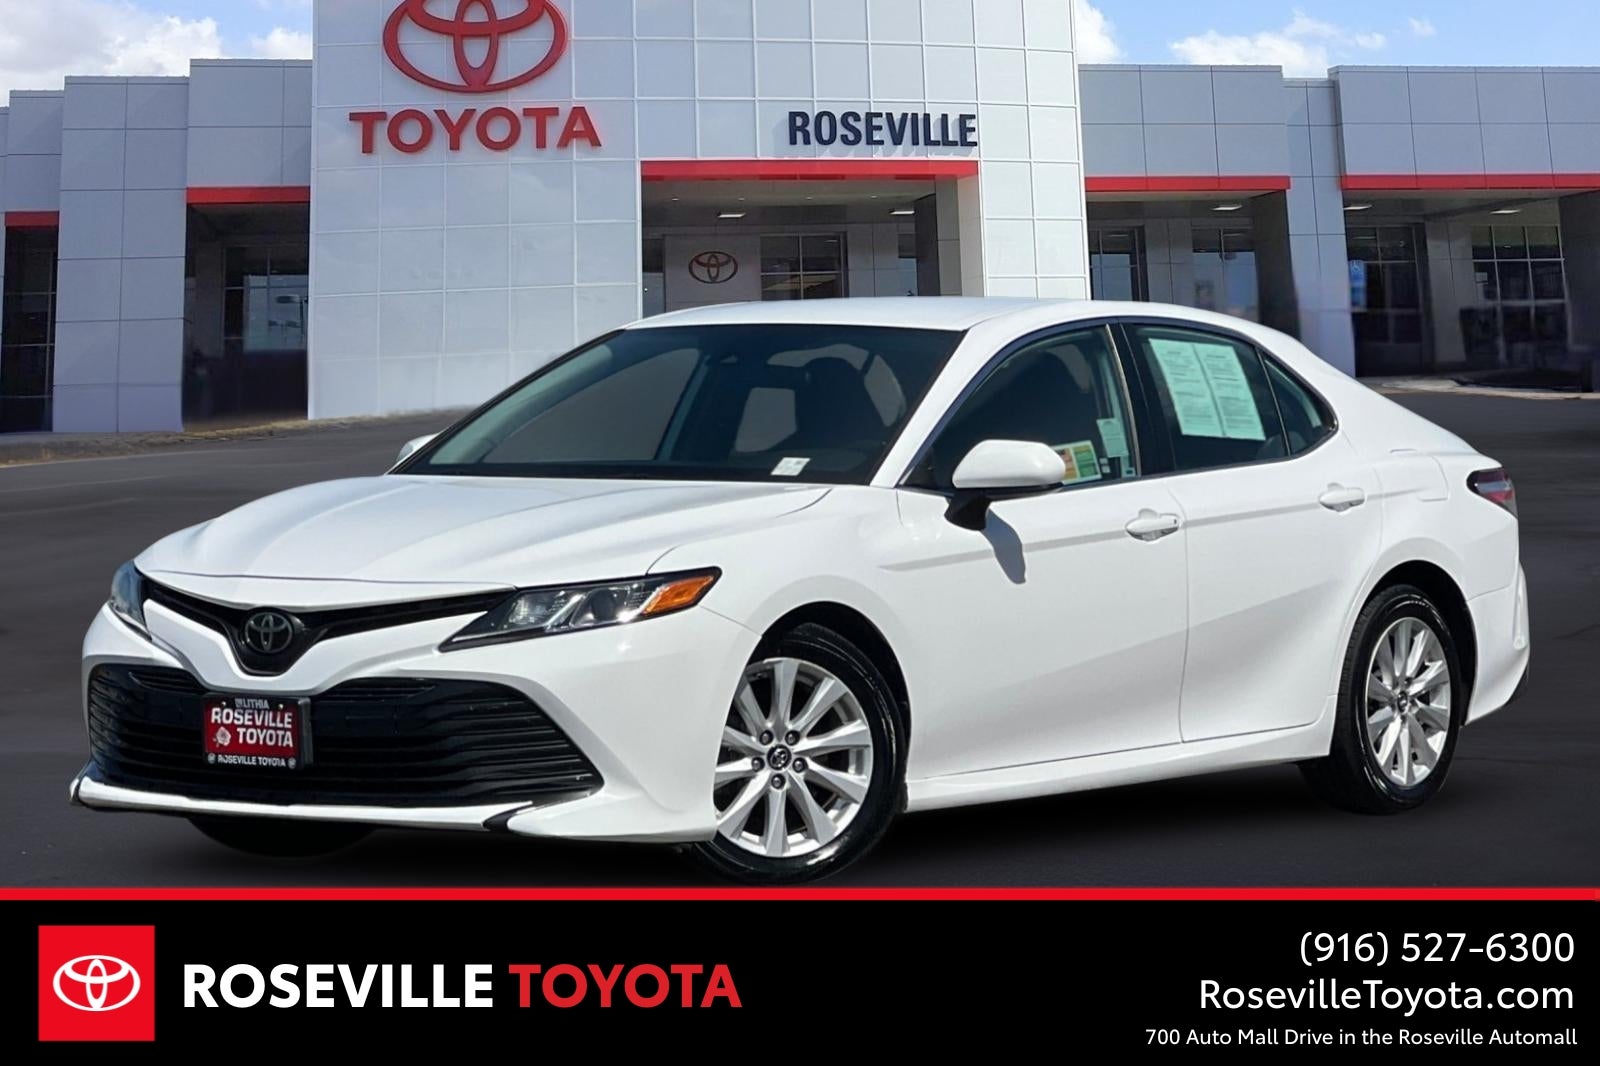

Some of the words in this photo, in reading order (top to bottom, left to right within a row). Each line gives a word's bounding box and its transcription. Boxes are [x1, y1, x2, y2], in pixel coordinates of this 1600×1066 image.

[349, 106, 602, 154] TOYOTA
[788, 110, 978, 147] ROSEVILLE
[242, 698, 270, 709] LITHIA
[211, 707, 293, 728] ROSEVILLE
[236, 727, 294, 748] TOYOTA
[258, 756, 287, 767] TOYOTA
